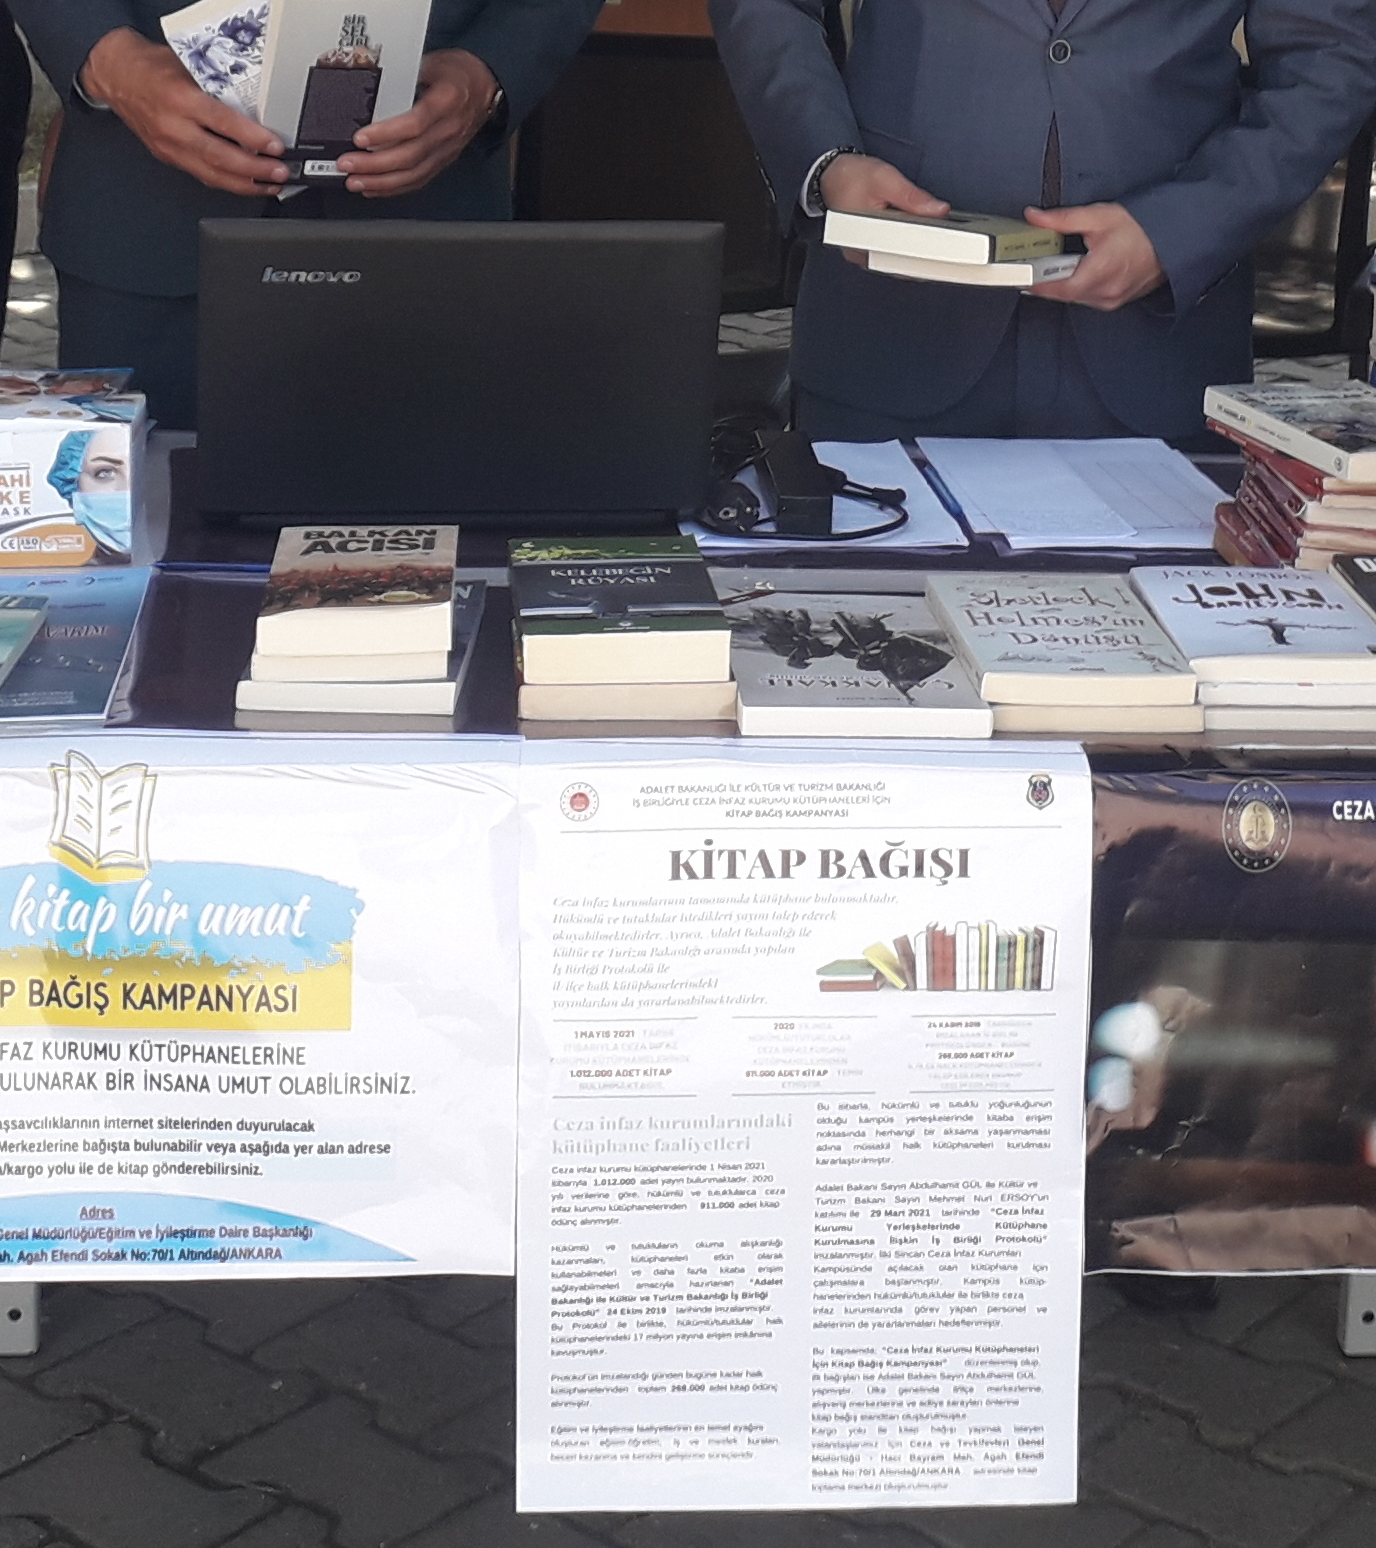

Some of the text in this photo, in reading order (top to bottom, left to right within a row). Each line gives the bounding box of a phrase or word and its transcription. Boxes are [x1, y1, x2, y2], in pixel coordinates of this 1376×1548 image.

[262, 265, 362, 284] lenovo
[302, 529, 438, 540] BALKAN
[299, 537, 436, 555] ACISI
[1162, 569, 1216, 580] JACK
[968, 586, 1117, 609] Sherlock
[1171, 581, 1327, 604] JOHN
[1332, 799, 1376, 821] CEZA
[668, 838, 971, 887] KİTAP BAĞIŞI
[10, 883, 115, 959] kitap
[129, 882, 188, 935] bir
[198, 894, 312, 938] umut
[28, 975, 110, 1017] BAĞIŞ
[122, 982, 298, 1014] KAMPANYASI
[42, 1040, 121, 1062] KURUMU
[128, 1038, 307, 1066] KÜTÜPHANELERİNE
[105, 1068, 135, 1092] BİR
[143, 1068, 211, 1094] İNSANA
[217, 1074, 273, 1095] UMUT
[278, 1071, 417, 1096] OLABİLİRSİNİZ.
[103, 1117, 154, 1130] internet
[156, 1117, 233, 1132] sitelerinden
[235, 1117, 316, 1136] duyurulacak
[82, 1140, 131, 1156] bağışta
[133, 1140, 203, 1153] bulunabilir
[205, 1142, 237, 1157] veya
[239, 1140, 290, 1158] aşağıda
[293, 1143, 314, 1158] yer
[316, 1141, 345, 1155] alan
[347, 1140, 392, 1155] adrese
[47, 1162, 76, 1179] yolu
[78, 1162, 94, 1176] ile
[97, 1162, 114, 1176] de
[117, 1162, 149, 1178] kitap
[152, 1162, 264, 1178] gönderebilirsiniz.
[79, 1205, 116, 1221] Adres
